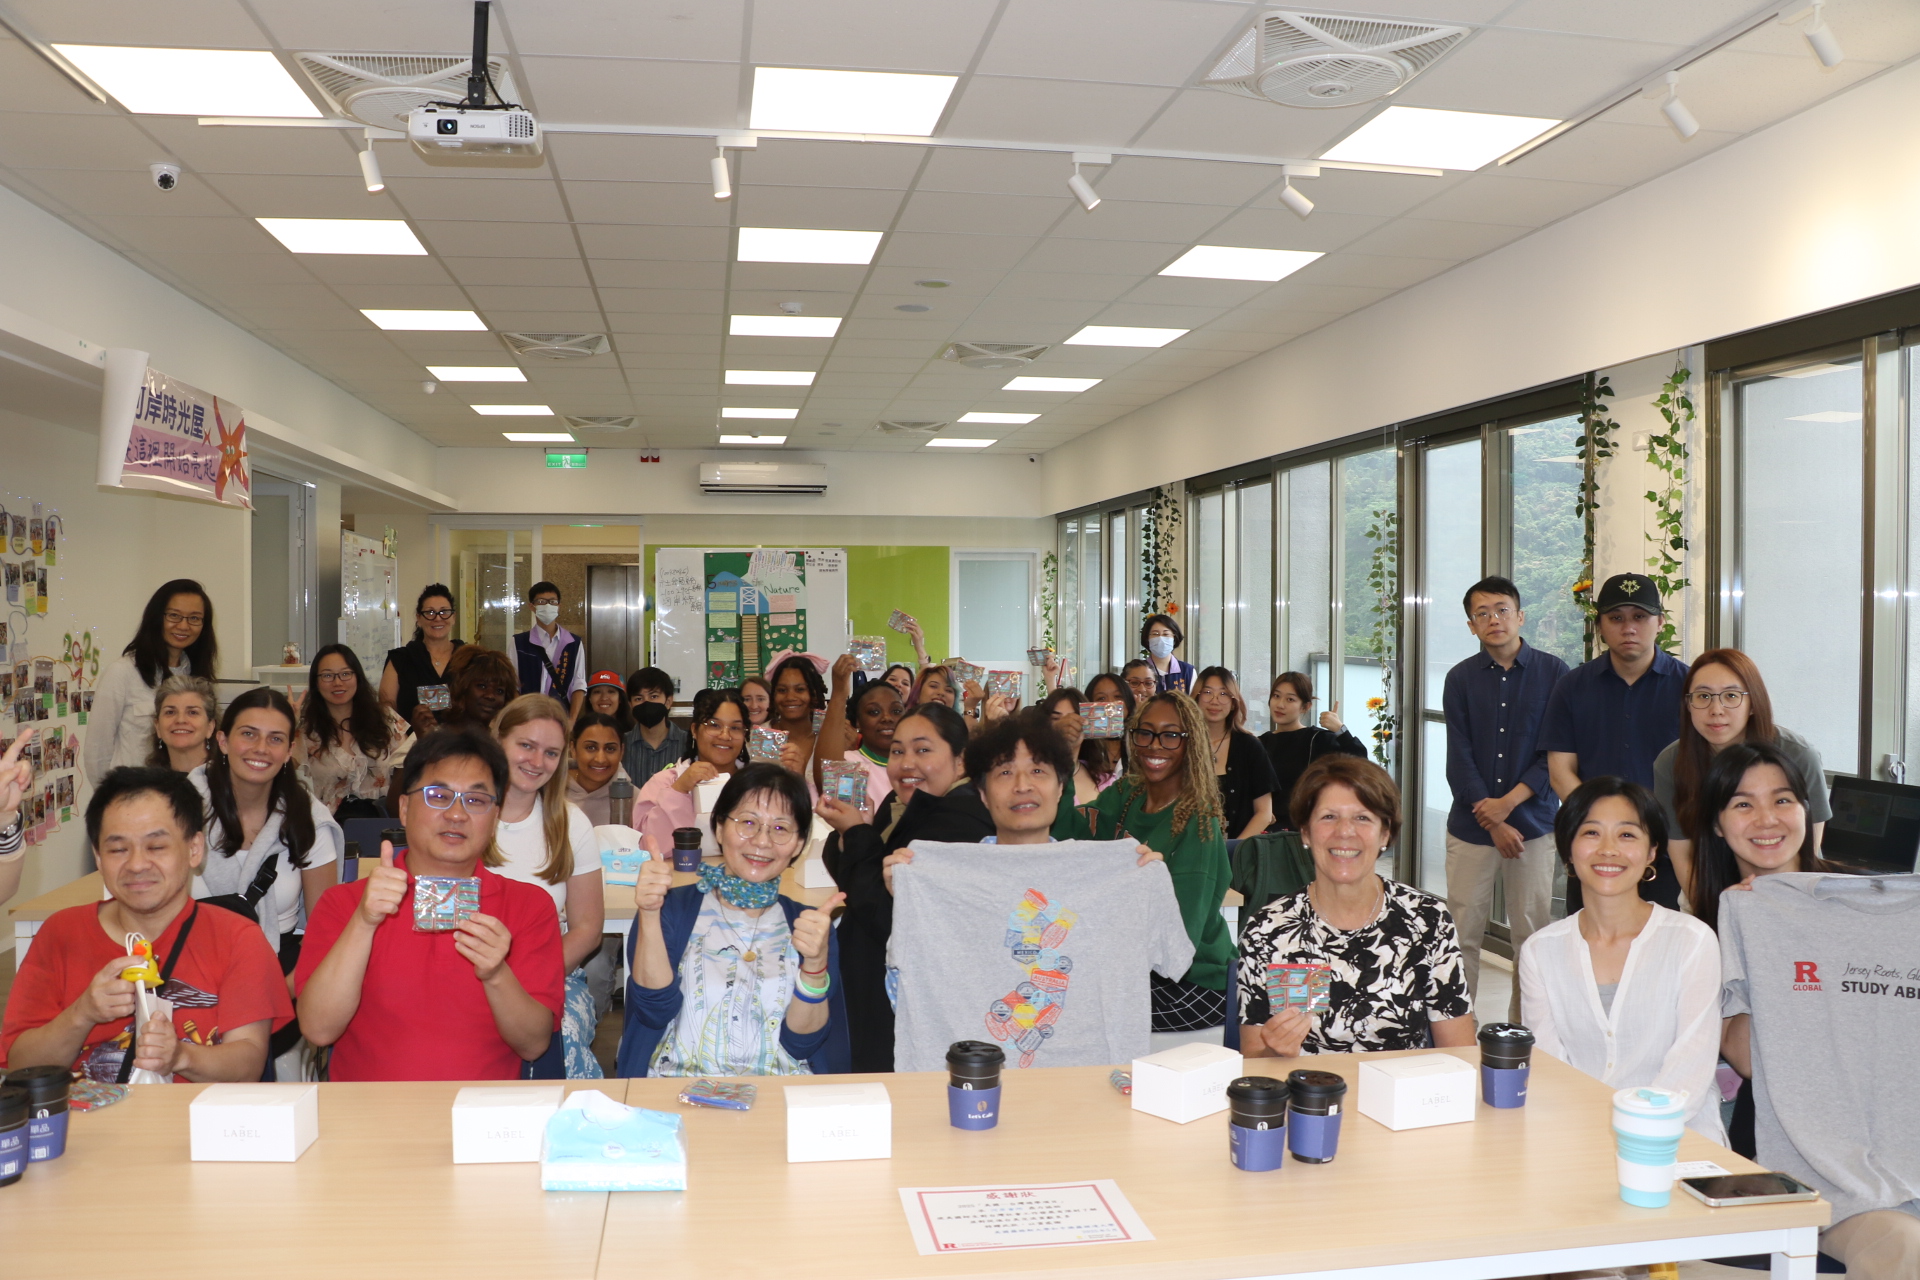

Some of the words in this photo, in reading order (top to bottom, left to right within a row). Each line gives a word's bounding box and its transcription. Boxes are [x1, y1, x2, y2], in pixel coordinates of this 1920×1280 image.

[707, 574, 717, 589] 5
[763, 584, 801, 595] Nature
[1793, 961, 1821, 983] R
[1842, 963, 1871, 979] Jersey
[1033, 974, 1065, 985] AUSTRALIA
[1841, 980, 1889, 995] STUDY
[1202, 1083, 1225, 1096] LABEL
[1421, 1094, 1451, 1105] LABEL
[223, 1129, 261, 1138] LABEL
[486, 1130, 525, 1139] LABEL
[821, 1130, 858, 1138] LABEL
[986, 1191, 1037, 1200] 感謝狀
